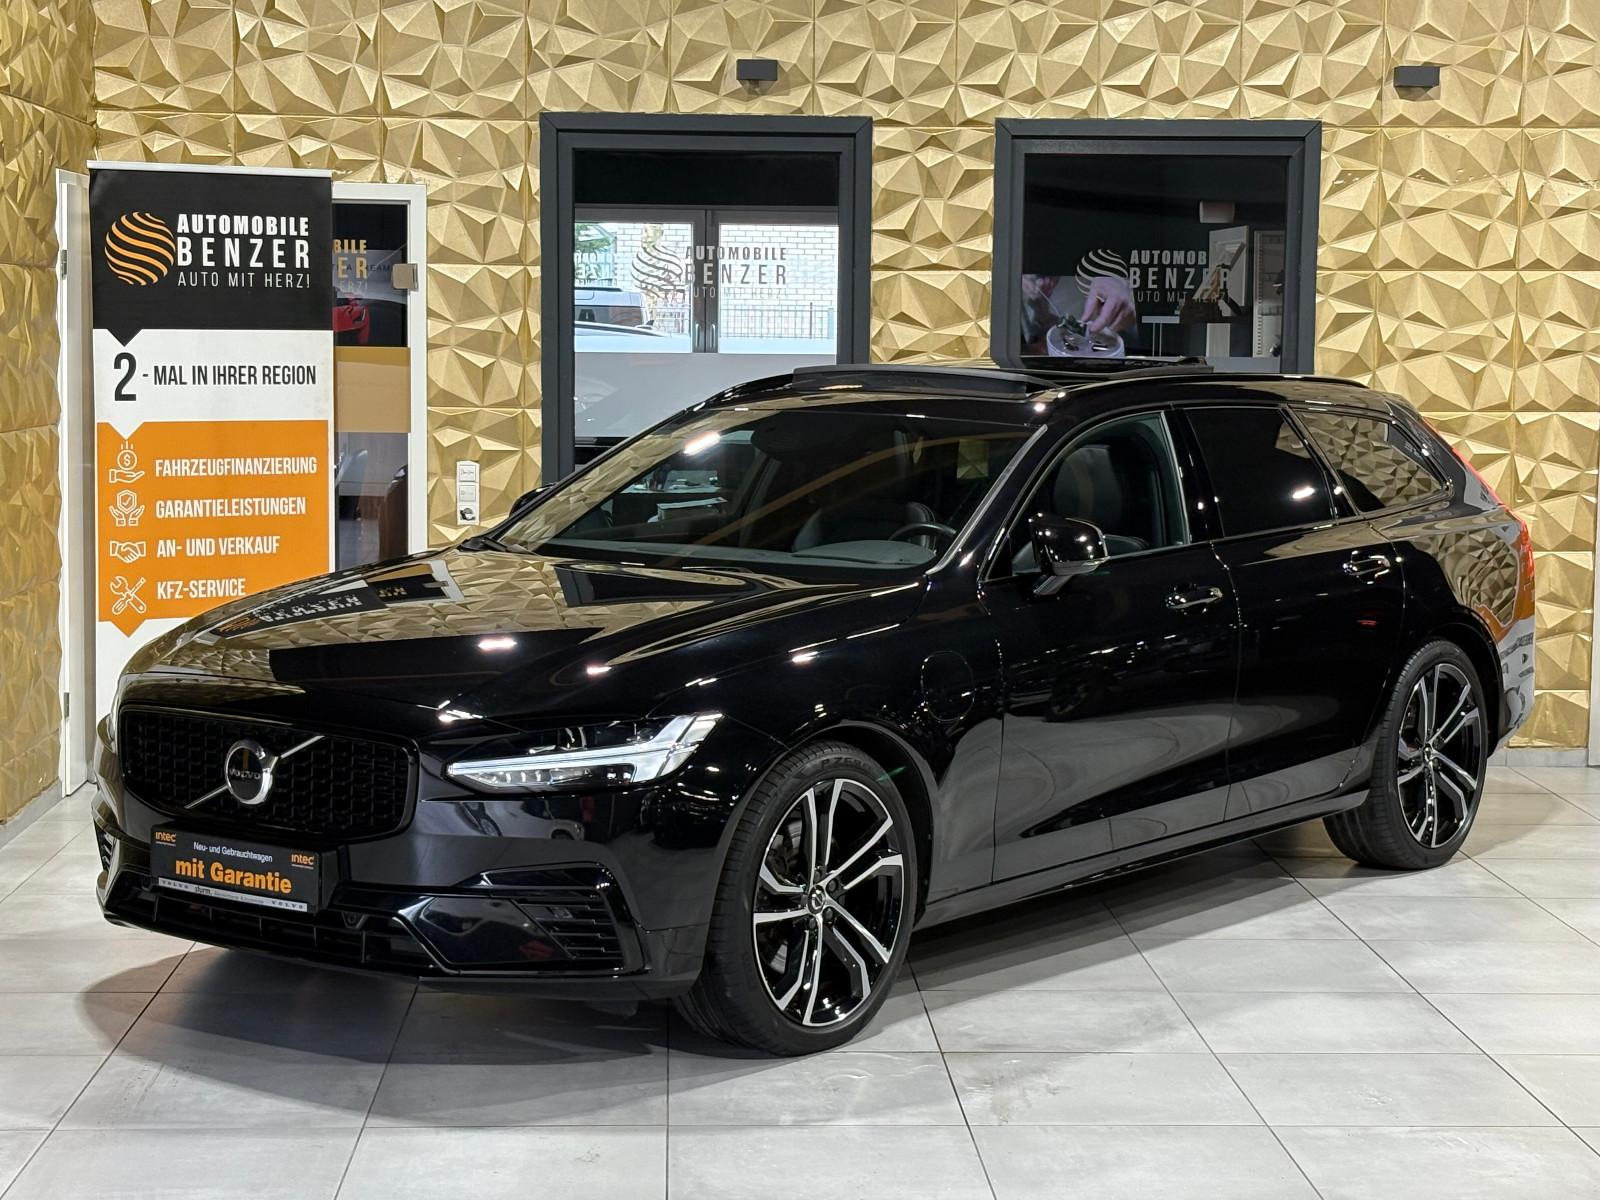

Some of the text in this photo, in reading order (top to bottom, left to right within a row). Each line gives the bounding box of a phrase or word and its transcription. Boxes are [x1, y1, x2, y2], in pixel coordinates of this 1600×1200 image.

[176, 213, 309, 237] AUTOMOBILE
[176, 236, 311, 269] BENZER
[685, 245, 787, 261] AUTOMOBILE
[177, 271, 311, 289] AUTO MIT HERZ!
[685, 262, 787, 285] BENZER
[113, 352, 137, 402] 2
[192, 365, 208, 386] IN
[212, 365, 257, 386] IHRER
[262, 365, 317, 386] REGION
[155, 456, 317, 477] FAHRZEUGFINANZIERUNG
[156, 496, 306, 519] GARANTIELEISTUNGEN
[156, 535, 281, 558] AN- UND VERKAUF
[157, 577, 246, 600] KFZ-SERVICE
[155, 831, 177, 843] intec
[193, 841, 273, 864] Neu- und Gebrauchtwagen
[290, 853, 315, 866] intec
[175, 858, 292, 894] mit Garantie
